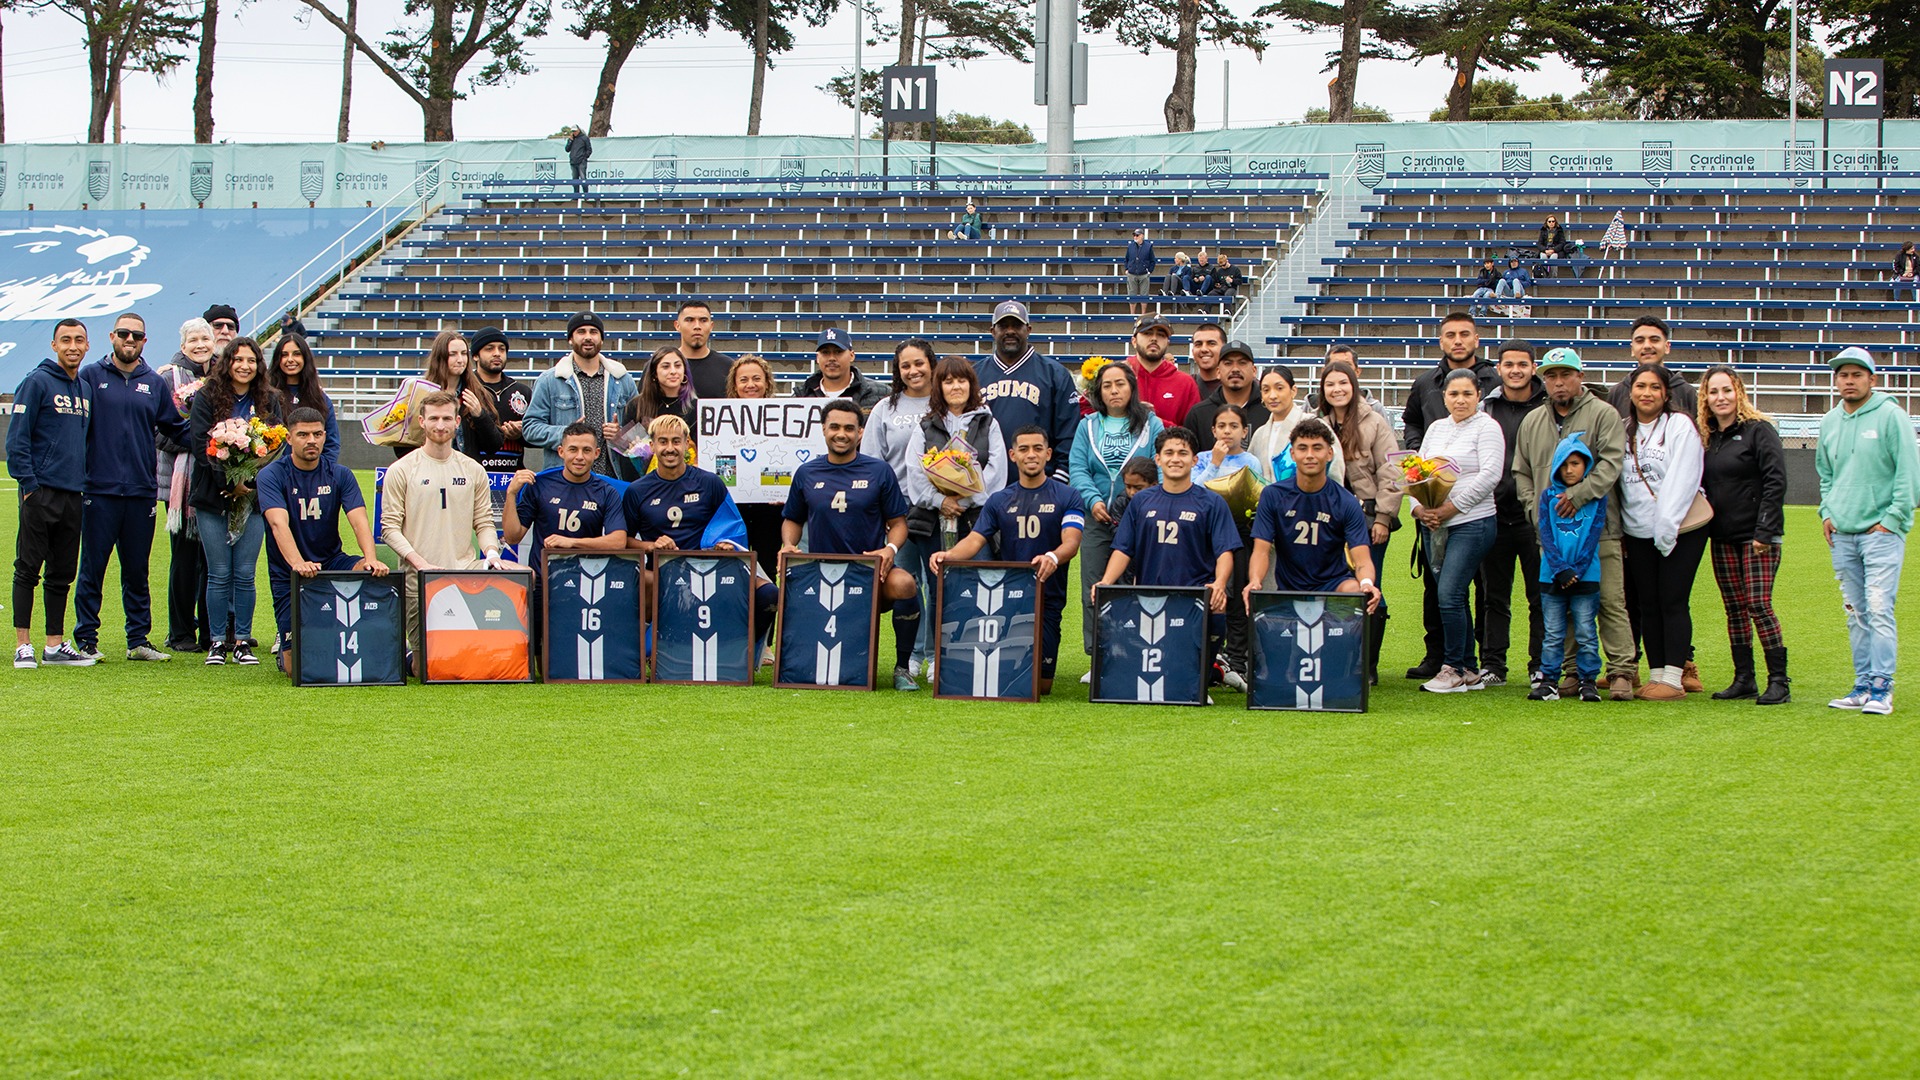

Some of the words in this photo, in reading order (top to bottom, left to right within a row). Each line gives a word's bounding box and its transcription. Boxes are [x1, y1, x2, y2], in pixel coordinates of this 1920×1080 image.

[890, 77, 927, 110] N1
[1829, 70, 1877, 106] N2
[655, 160, 675, 170] UNION
[783, 160, 803, 170] UNION
[1207, 155, 1229, 166] UNION
[1248, 157, 1306, 171] Cardinale
[1402, 155, 1465, 167] Cardinale
[1549, 155, 1613, 166] Cardinale
[1690, 154, 1755, 165] Cardinale
[90, 165, 109, 175] UNION
[192, 166, 212, 176] UNION
[303, 165, 323, 176] UNION
[535, 162, 554, 172] UNION
[693, 167, 750, 178] Cardinale
[18, 172, 65, 182] Cardinale
[121, 172, 170, 183] Cardinale
[225, 173, 274, 183] Cardinale
[336, 172, 388, 182] Cardinale
[452, 171, 505, 181] Cardinale
[121, 183, 169, 191] STADIUM
[225, 183, 274, 191] STADIUM
[1105, 436, 1130, 447] UNION
[452, 477, 467, 486] MB
[851, 480, 869, 489] MB
[317, 485, 332, 496] MB
[439, 487, 447, 510] 1
[683, 493, 700, 503] MB
[831, 490, 848, 513] 4
[298, 497, 322, 521] 14
[582, 500, 598, 511] MB
[1038, 503, 1056, 513] MB
[558, 508, 582, 533] 16
[666, 506, 683, 528] 9
[1178, 511, 1197, 522] MB
[1315, 511, 1331, 523] MB
[1016, 515, 1041, 539] 10
[1156, 520, 1179, 545] 12
[1293, 521, 1319, 546] 21
[610, 580, 625, 589] MB
[720, 576, 735, 585] MB
[848, 586, 863, 595] MB
[1008, 590, 1023, 598] MB
[364, 602, 378, 610] MB
[581, 608, 602, 631] 16
[698, 605, 711, 629] 9
[1169, 618, 1185, 627] MB
[824, 614, 837, 638] 4
[978, 619, 999, 643] 10
[1328, 627, 1344, 636] MB
[339, 631, 359, 655] 14
[1141, 648, 1162, 673] 12
[1299, 657, 1321, 682] 21
